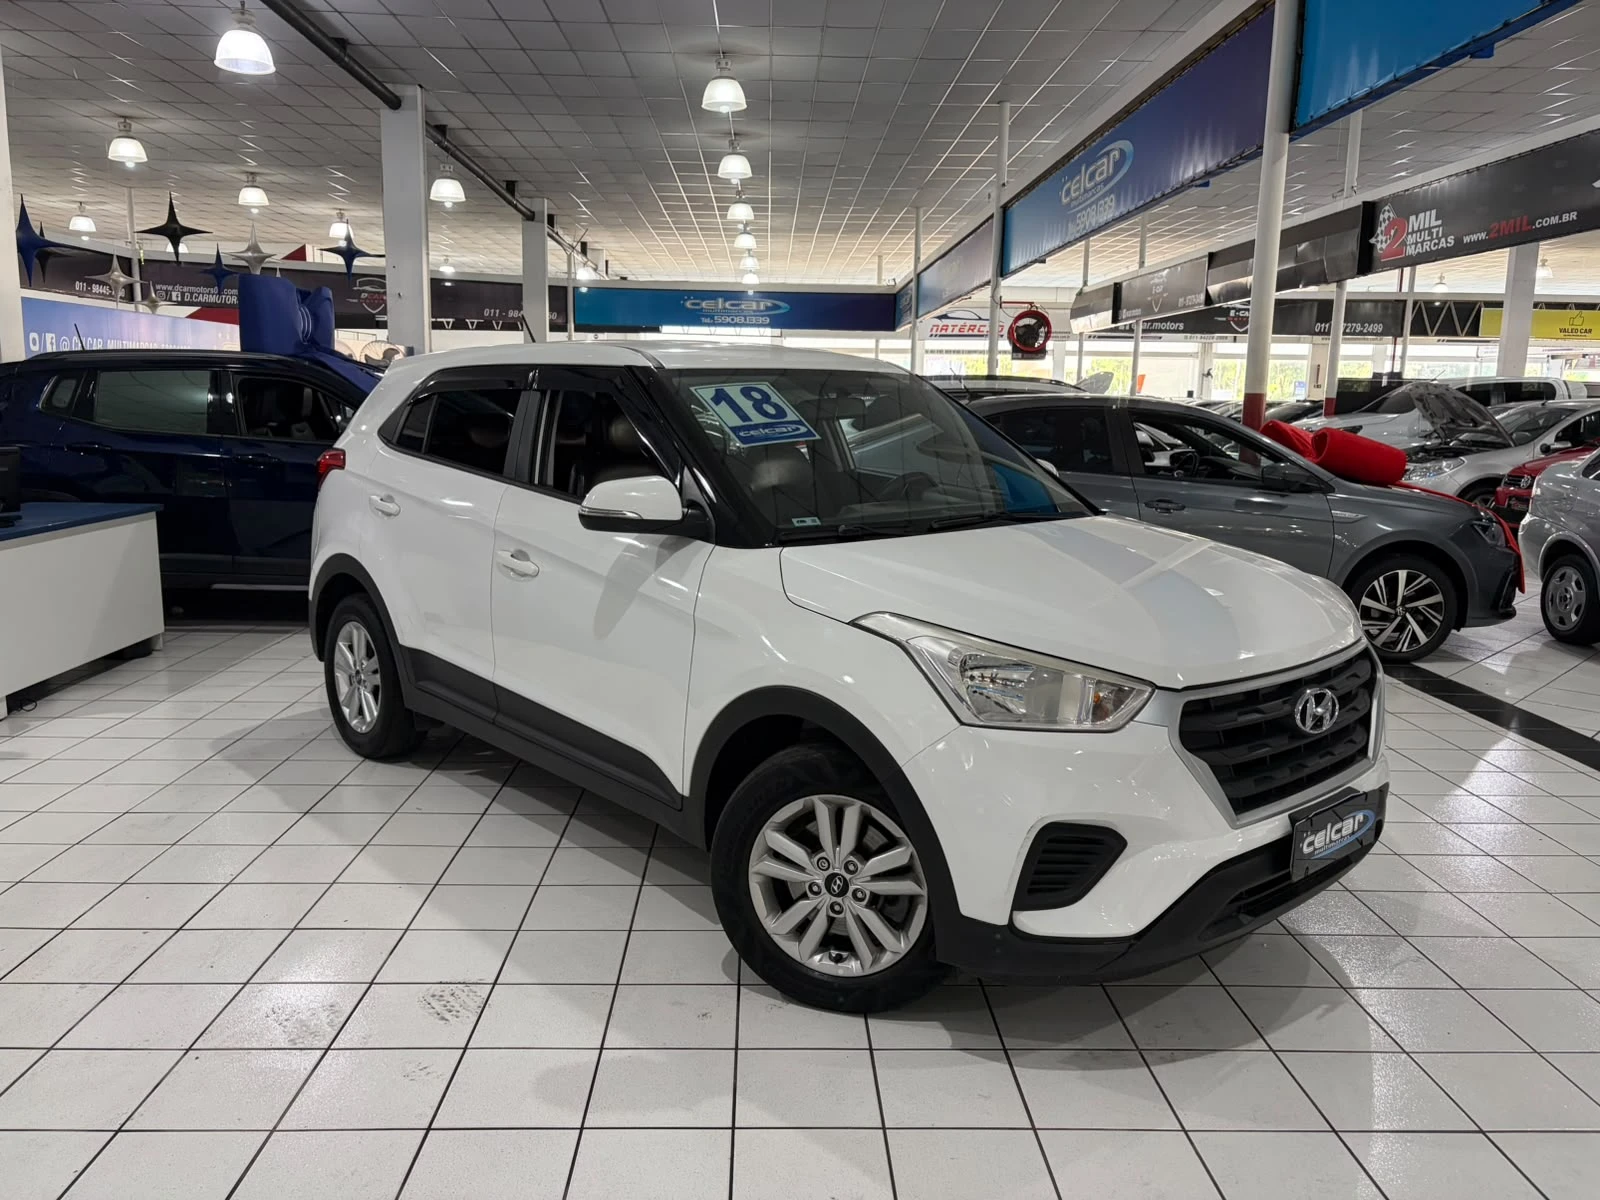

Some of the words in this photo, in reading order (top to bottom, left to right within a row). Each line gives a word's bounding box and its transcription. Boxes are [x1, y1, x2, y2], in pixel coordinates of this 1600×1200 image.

[1061, 149, 1120, 206] celcar
[1381, 217, 1408, 261] 2
[1408, 209, 1442, 232] MIL
[1406, 227, 1443, 244] MULTI
[1406, 236, 1455, 256] MARCAS
[75, 281, 87, 291] 011
[184, 293, 239, 305] D.CARMOTOR
[684, 297, 774, 310] celcar
[484, 308, 500, 317] 011
[1131, 320, 1184, 330] ear.motors
[1315, 322, 1329, 333] 011
[710, 386, 788, 423] 18
[738, 424, 798, 437] celcar
[1302, 812, 1364, 855] celcar
